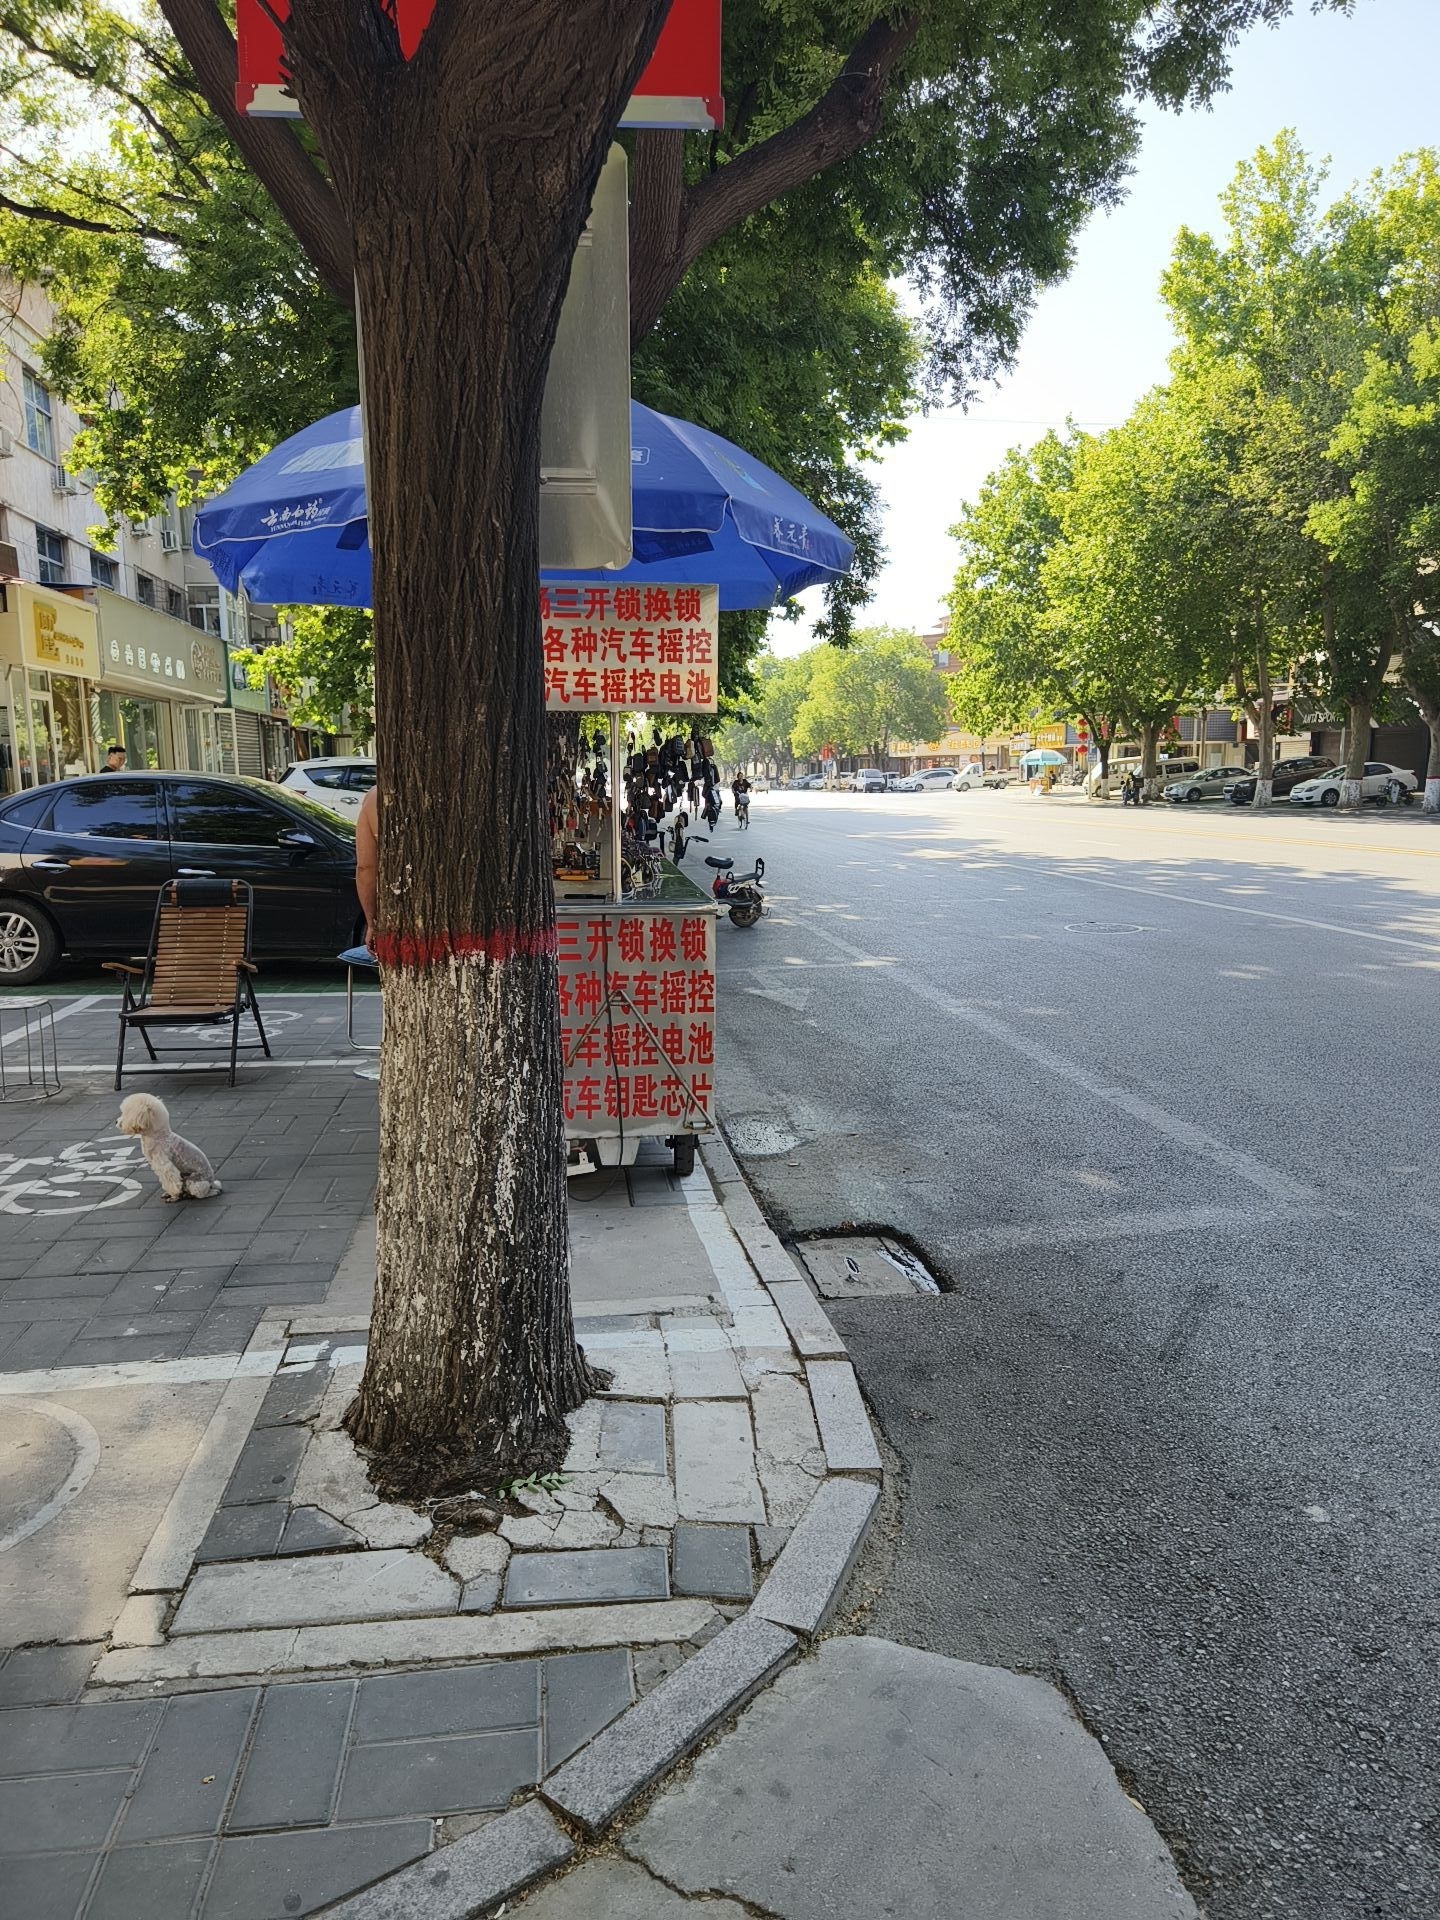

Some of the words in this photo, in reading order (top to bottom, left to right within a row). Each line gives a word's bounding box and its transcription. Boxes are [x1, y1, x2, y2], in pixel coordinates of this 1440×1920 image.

[543, 626, 713, 664] 各种汽车摇控
[544, 667, 712, 704] 汽车摇控电池
[558, 969, 715, 1016] 各种汽车摇控
